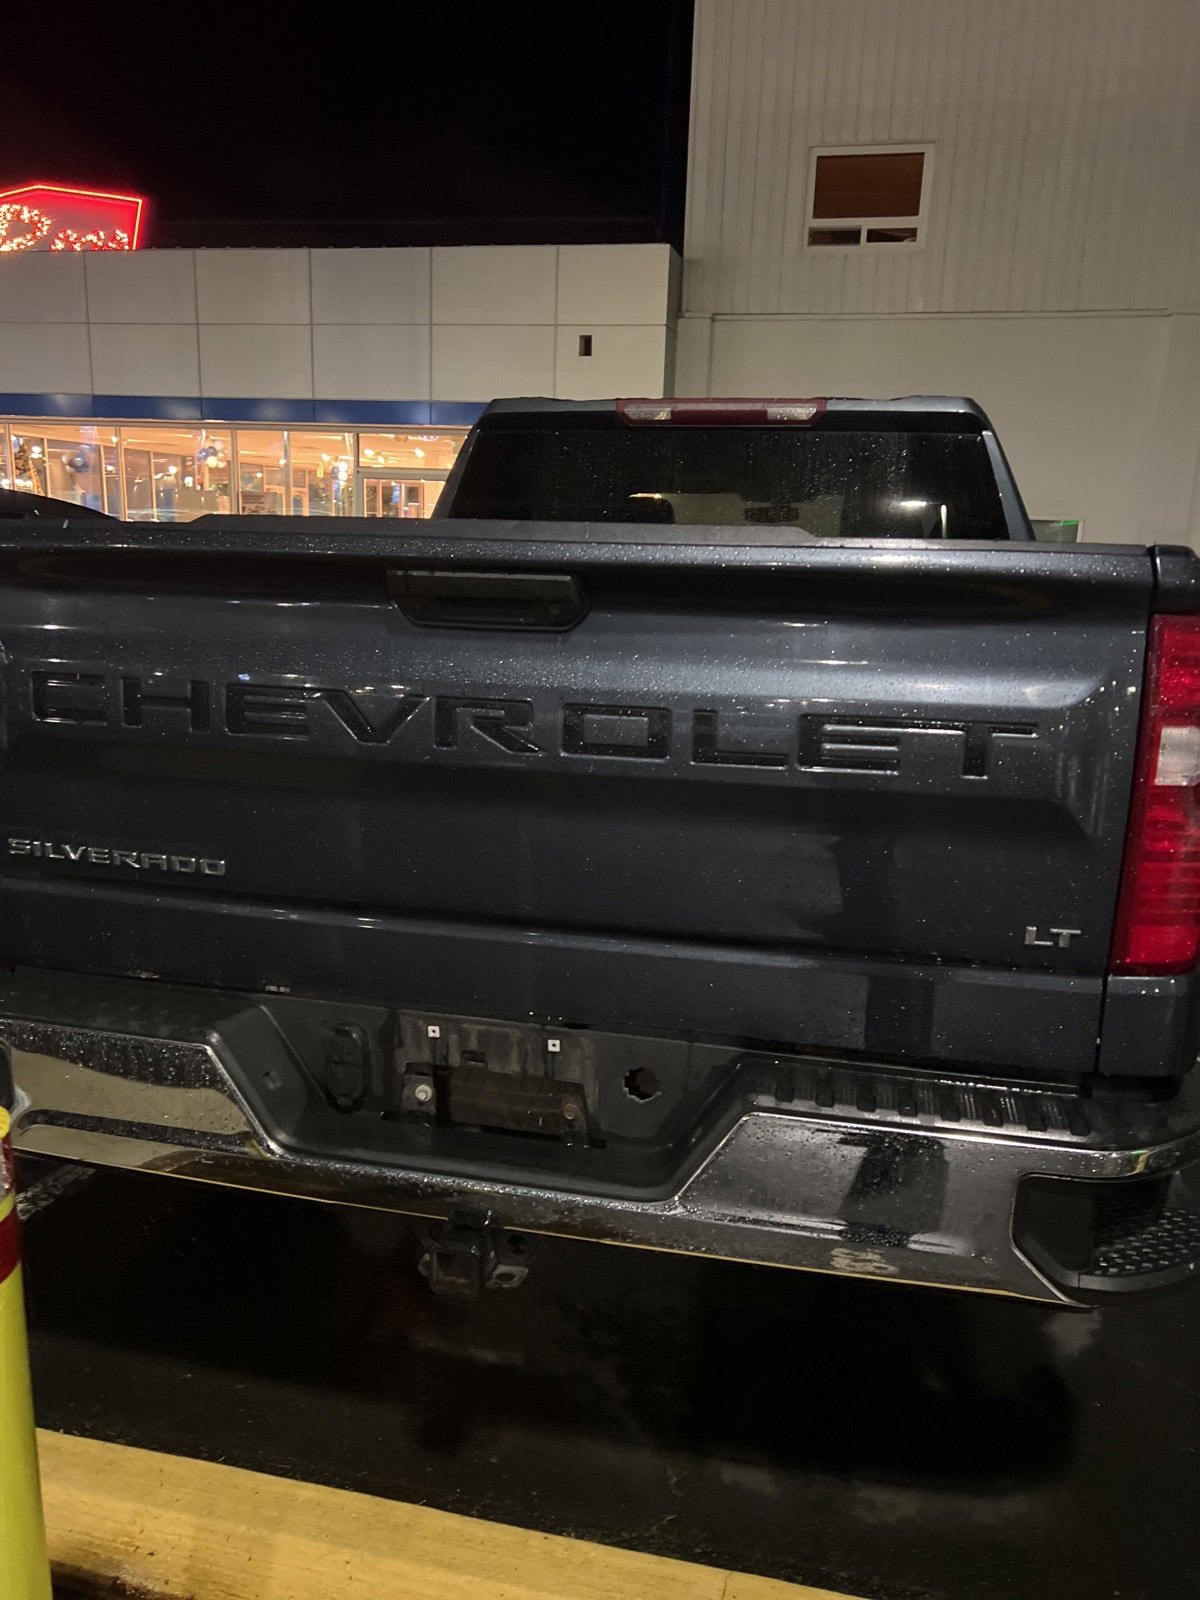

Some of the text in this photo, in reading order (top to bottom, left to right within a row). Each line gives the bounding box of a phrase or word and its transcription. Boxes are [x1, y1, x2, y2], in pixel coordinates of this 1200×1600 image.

[30, 669, 1039, 779] CHEVROLET
[7, 837, 227, 876] SILVERADO
[1024, 925, 1082, 949] LT
